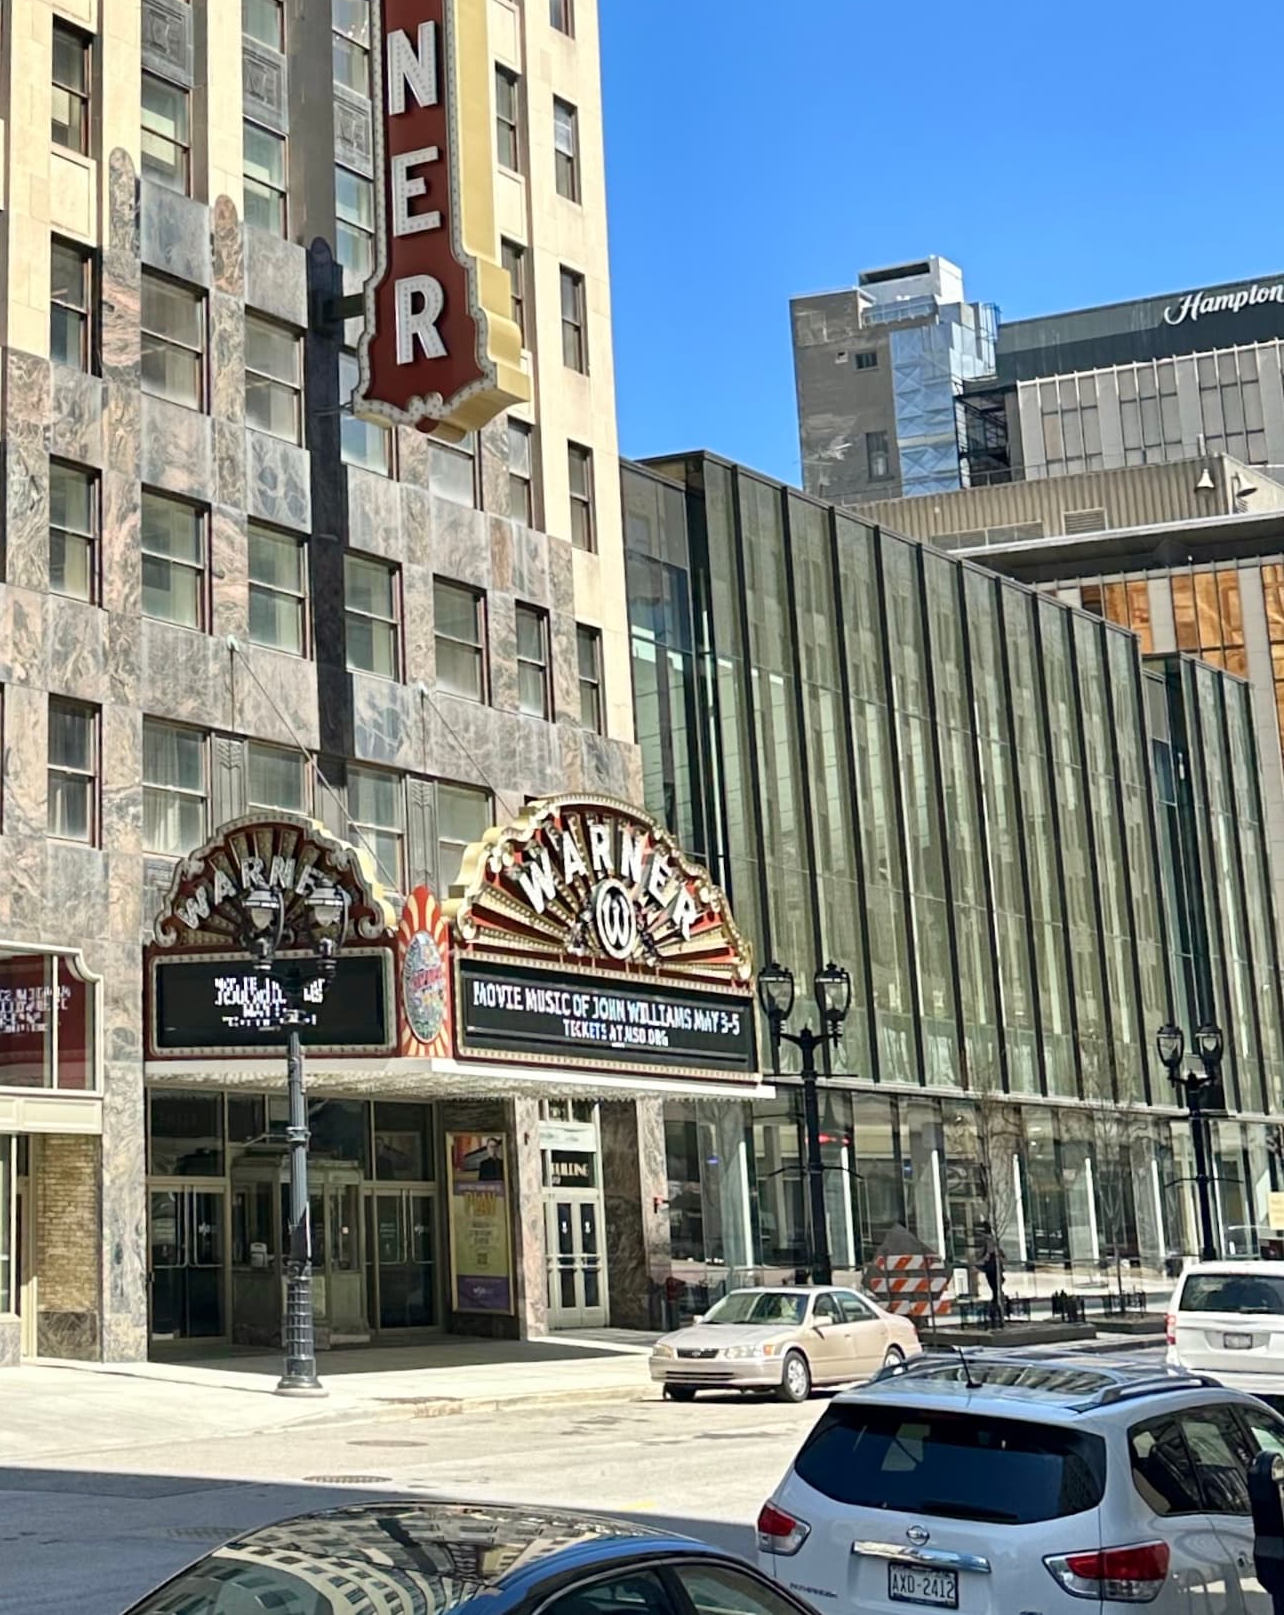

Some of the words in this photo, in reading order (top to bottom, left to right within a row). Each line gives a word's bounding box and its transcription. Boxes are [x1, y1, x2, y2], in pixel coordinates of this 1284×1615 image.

[1164, 284, 1284, 325] Hampton
[518, 824, 704, 942] WARNER
[473, 981, 523, 1011] MOVIE
[525, 987, 571, 1018] MUSIC
[572, 993, 590, 1018] OF
[592, 996, 625, 1023] JOHN
[627, 1000, 692, 1030] WILLIAMS
[694, 1009, 718, 1033] MAY
[719, 1012, 740, 1036] 3-5
[563, 1019, 606, 1041] TICKETS
[608, 1025, 624, 1043] AT
